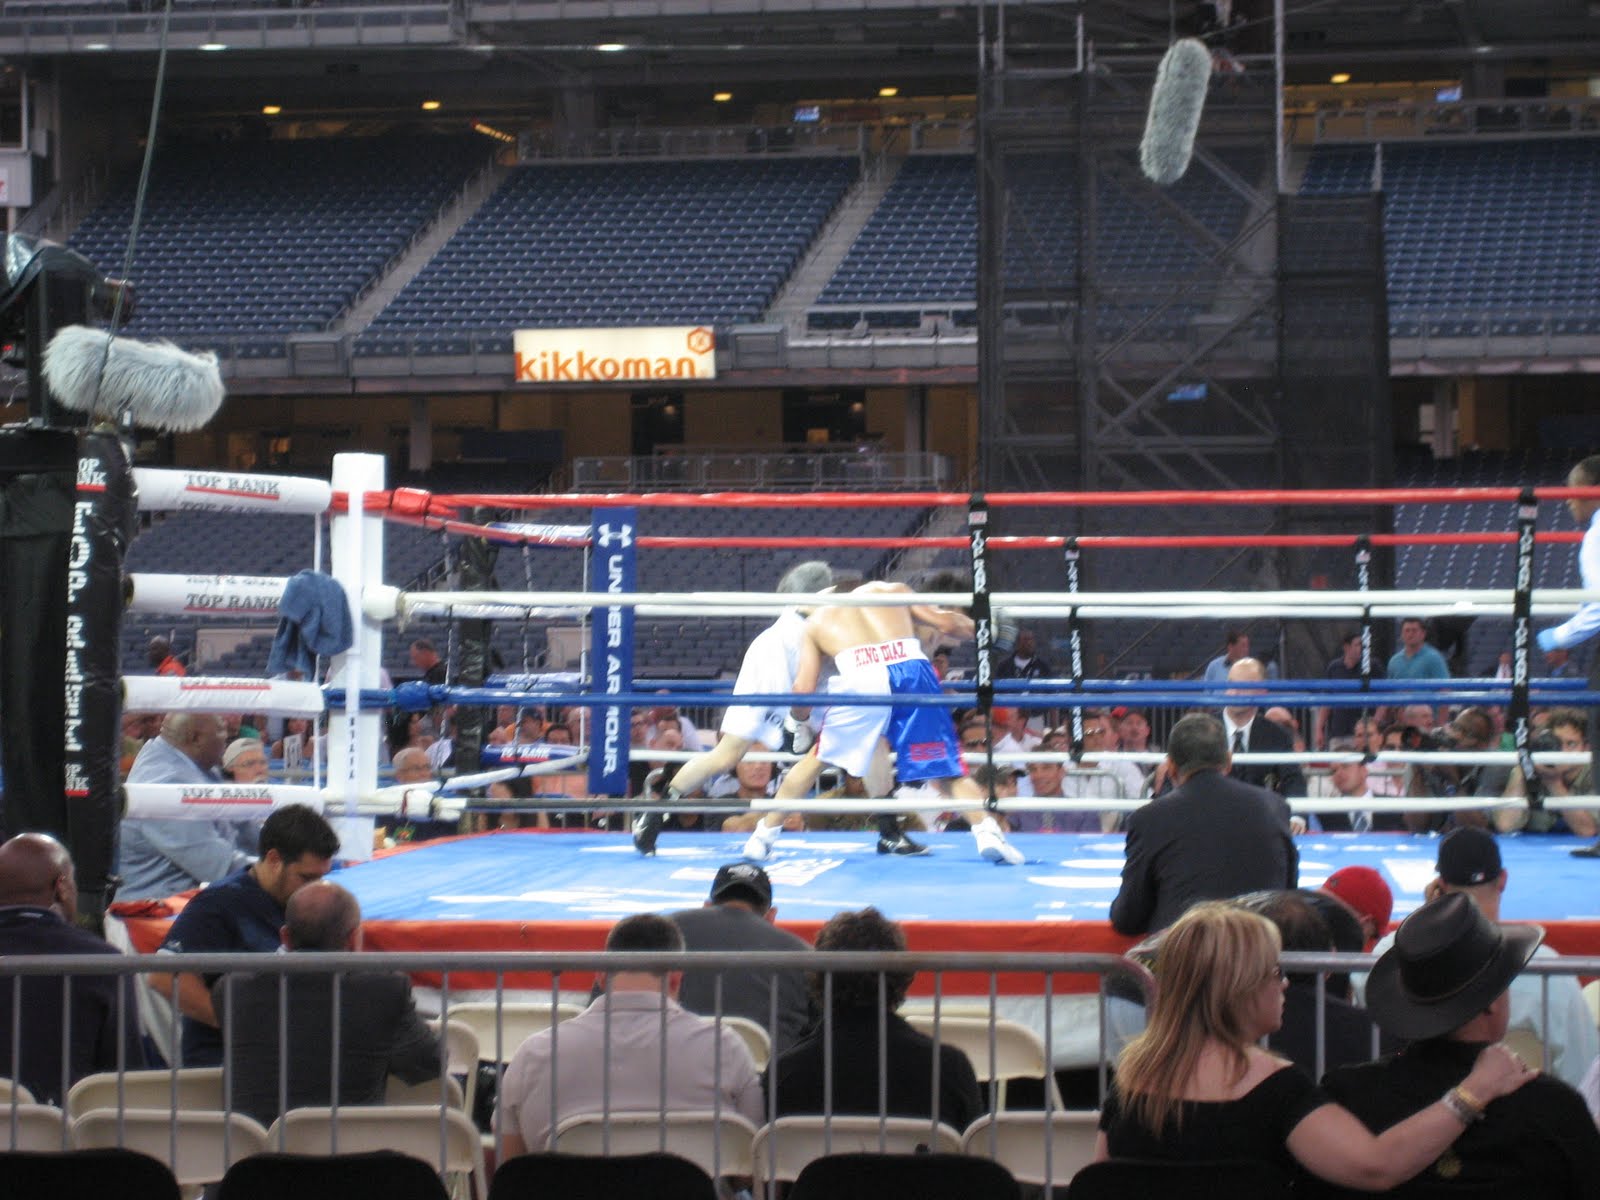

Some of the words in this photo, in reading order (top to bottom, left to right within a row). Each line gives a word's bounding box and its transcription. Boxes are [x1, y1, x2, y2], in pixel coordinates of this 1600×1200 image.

[514, 350, 697, 381] kikkoman
[185, 474, 220, 489] TOP
[227, 478, 281, 495] RANK
[186, 592, 224, 609] TOP
[226, 594, 281, 609] RANK
[880, 641, 908, 662] DIAZ
